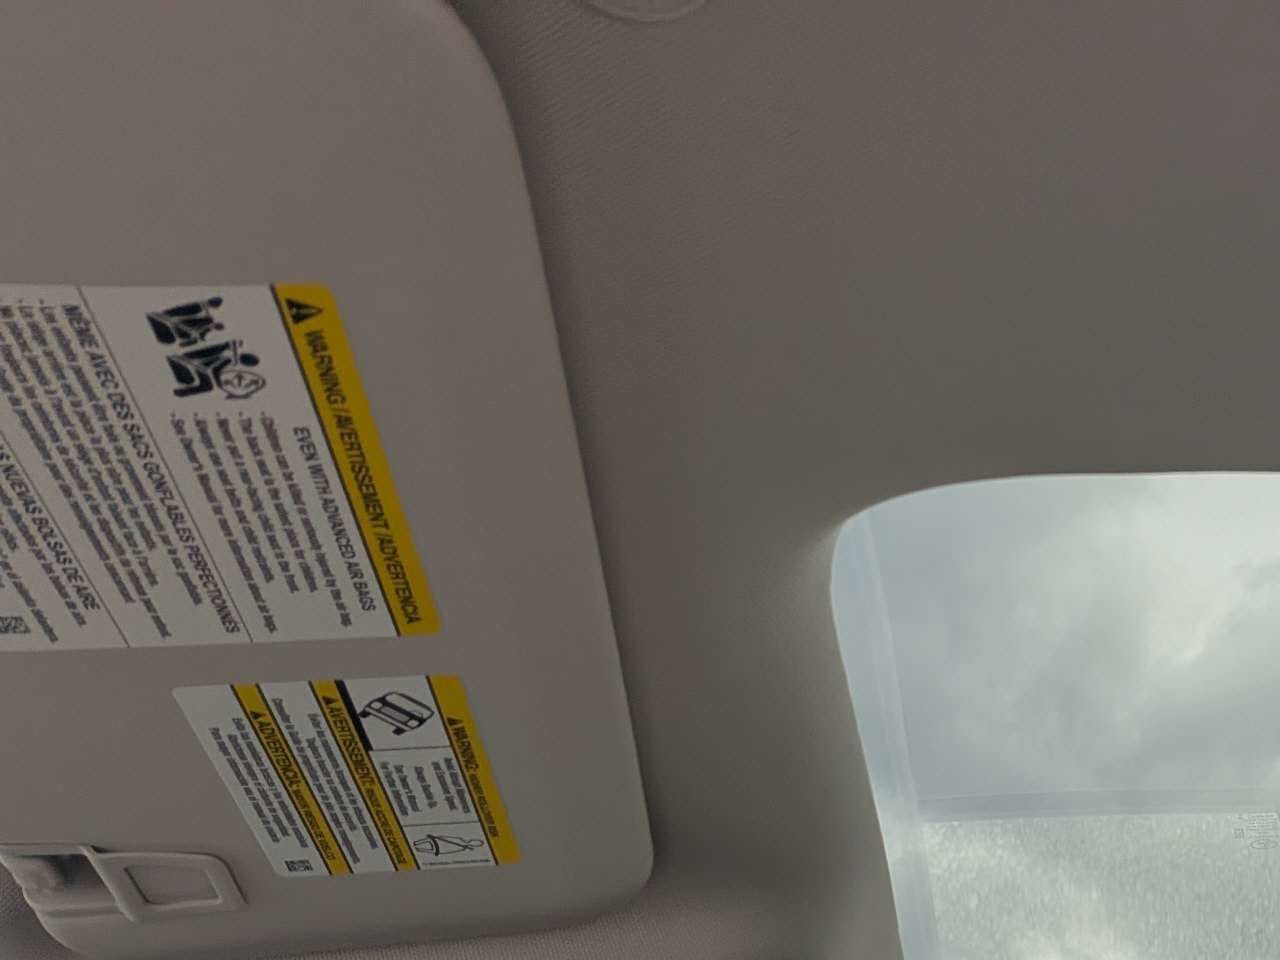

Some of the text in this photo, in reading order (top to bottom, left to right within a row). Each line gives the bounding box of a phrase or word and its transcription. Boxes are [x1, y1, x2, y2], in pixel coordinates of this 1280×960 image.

[85, 353, 122, 389] AVEC
[301, 330, 347, 401] WARNING
[105, 392, 138, 420] DES
[121, 424, 157, 458] SACS
[141, 462, 198, 541] GONFLABLES
[291, 427, 377, 611] EVEN WITH ADVANCED AIR BAGS
[32, 517, 72, 569] BOLSAS
[62, 566, 85, 586] DE
[74, 582, 100, 611] AIRE
